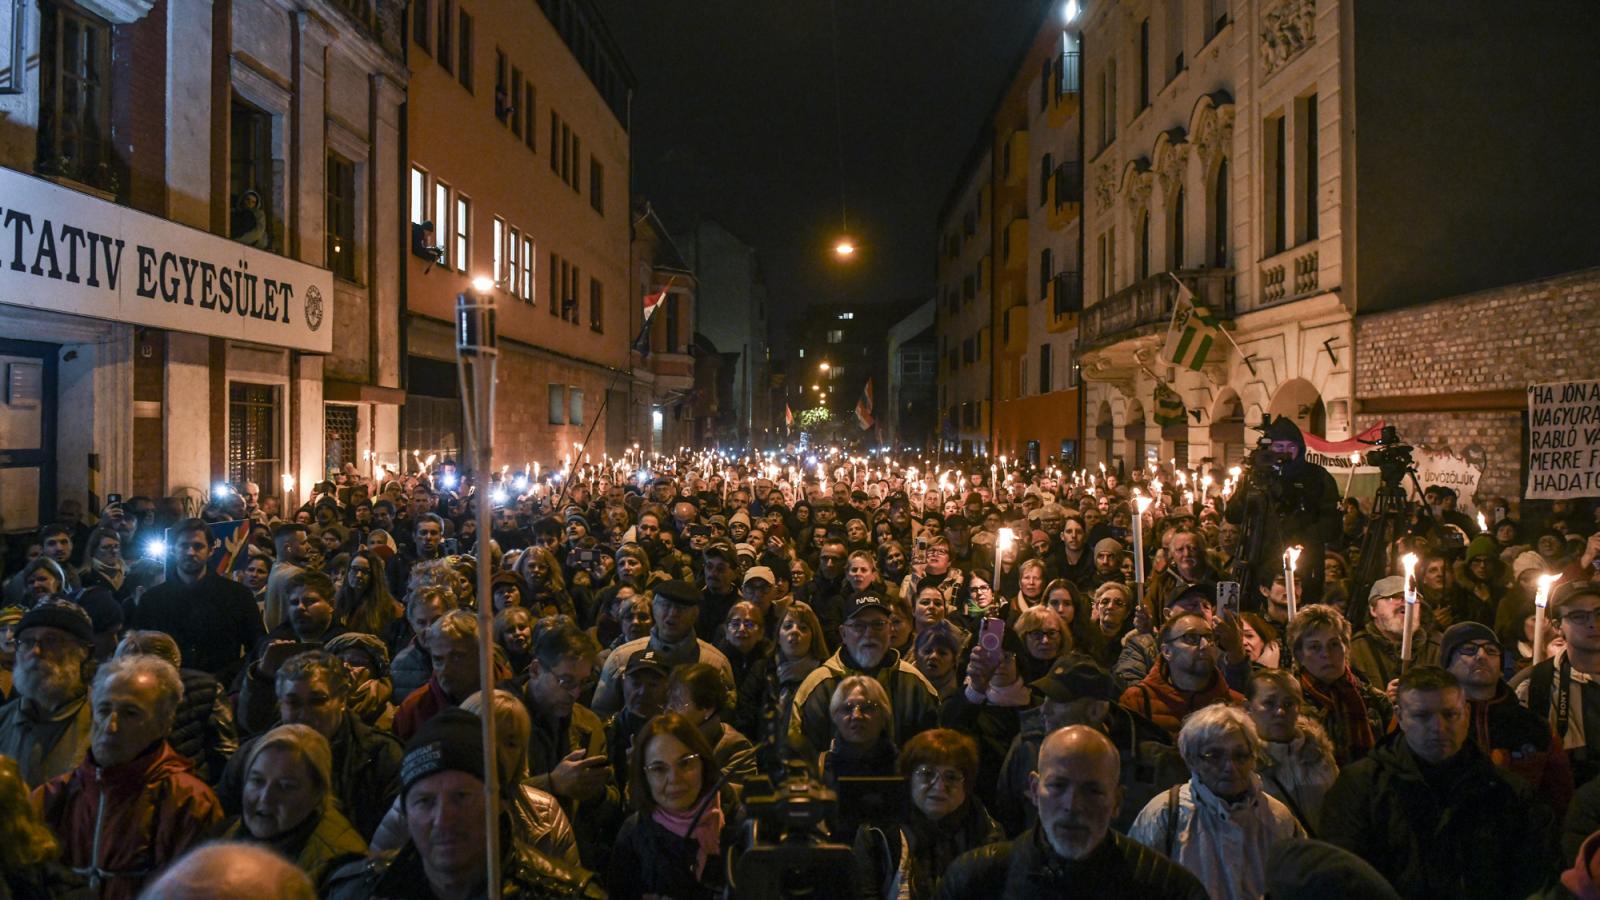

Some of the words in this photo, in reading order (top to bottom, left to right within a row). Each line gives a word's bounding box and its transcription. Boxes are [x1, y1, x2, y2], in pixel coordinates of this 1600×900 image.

[0, 207, 125, 290] TATIV
[136, 244, 294, 324] EGYESÜLET
[1532, 404, 1600, 427] NAGYURA
[1532, 426, 1577, 449] RABLÓ
[1530, 449, 1583, 471] MERRE
[855, 596, 881, 605] NASA
[1559, 689, 1568, 716] SONY
